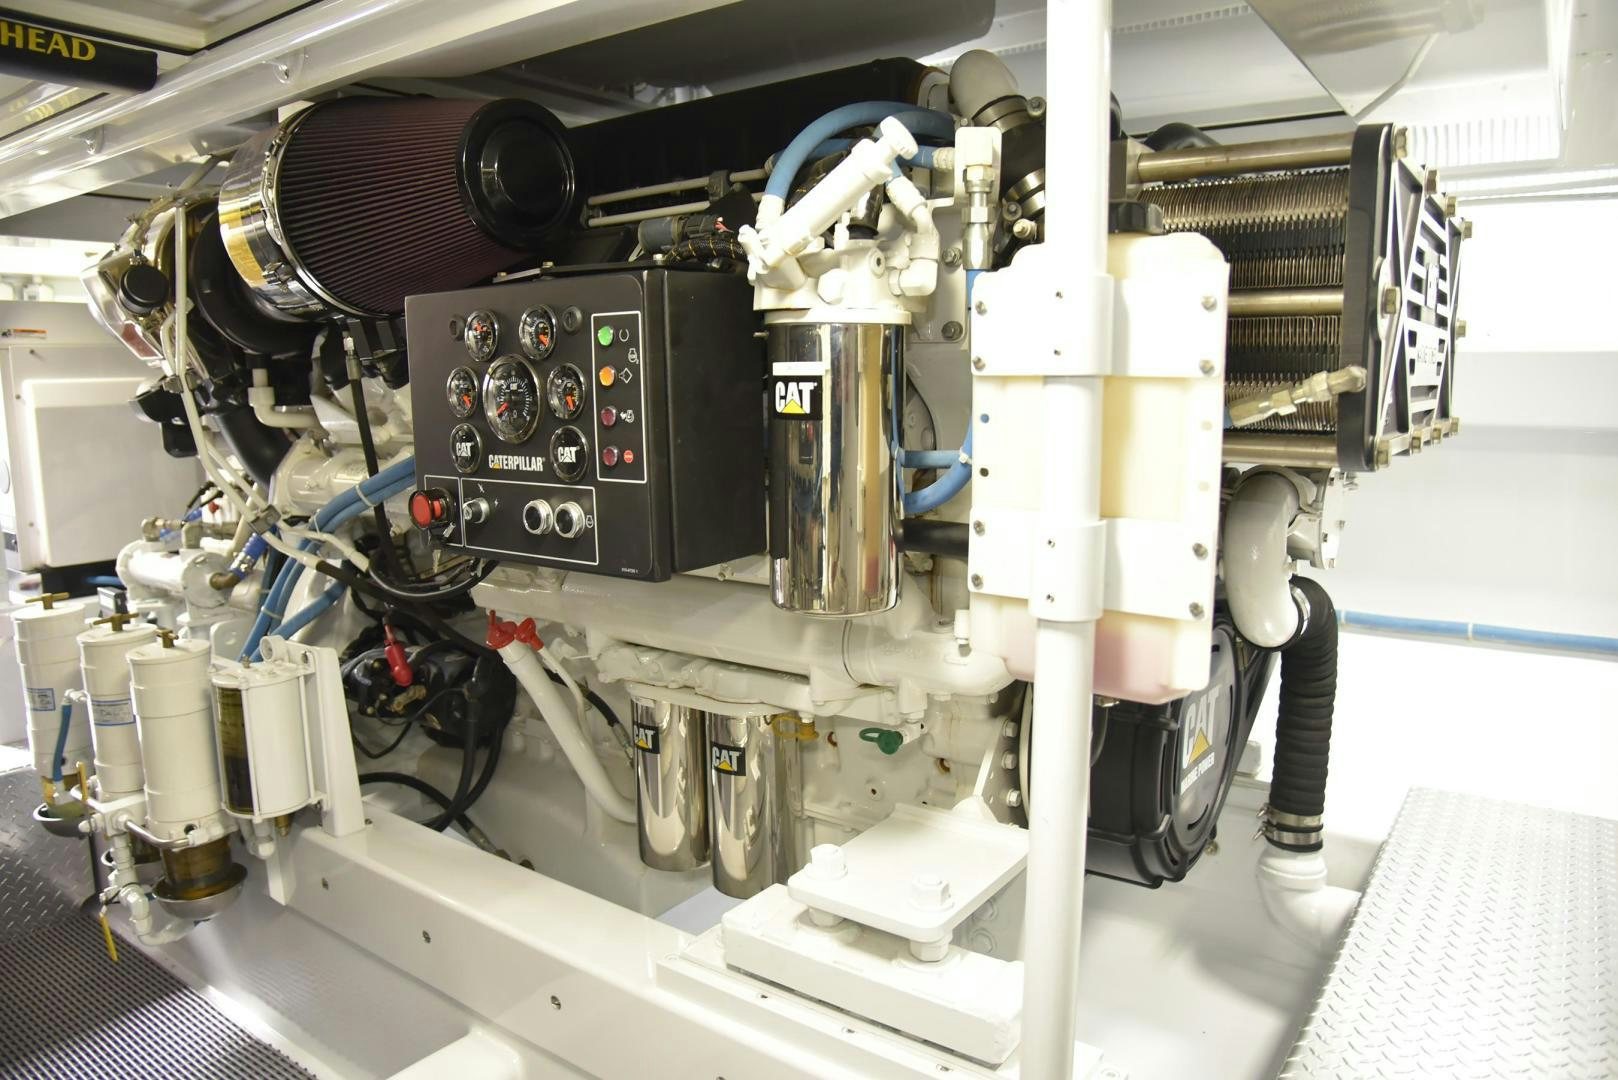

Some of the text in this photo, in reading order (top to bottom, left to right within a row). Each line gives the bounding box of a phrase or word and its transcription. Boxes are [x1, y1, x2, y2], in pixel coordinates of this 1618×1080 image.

[0, 20, 96, 61] HEAD
[775, 381, 815, 414] CAT
[456, 442, 471, 457] CAT
[557, 446, 577, 463] CAT
[488, 454, 544, 471] CATERPILLAR
[634, 724, 654, 749] CAT
[1183, 686, 1219, 769] CAT
[712, 746, 740, 772] CAT
